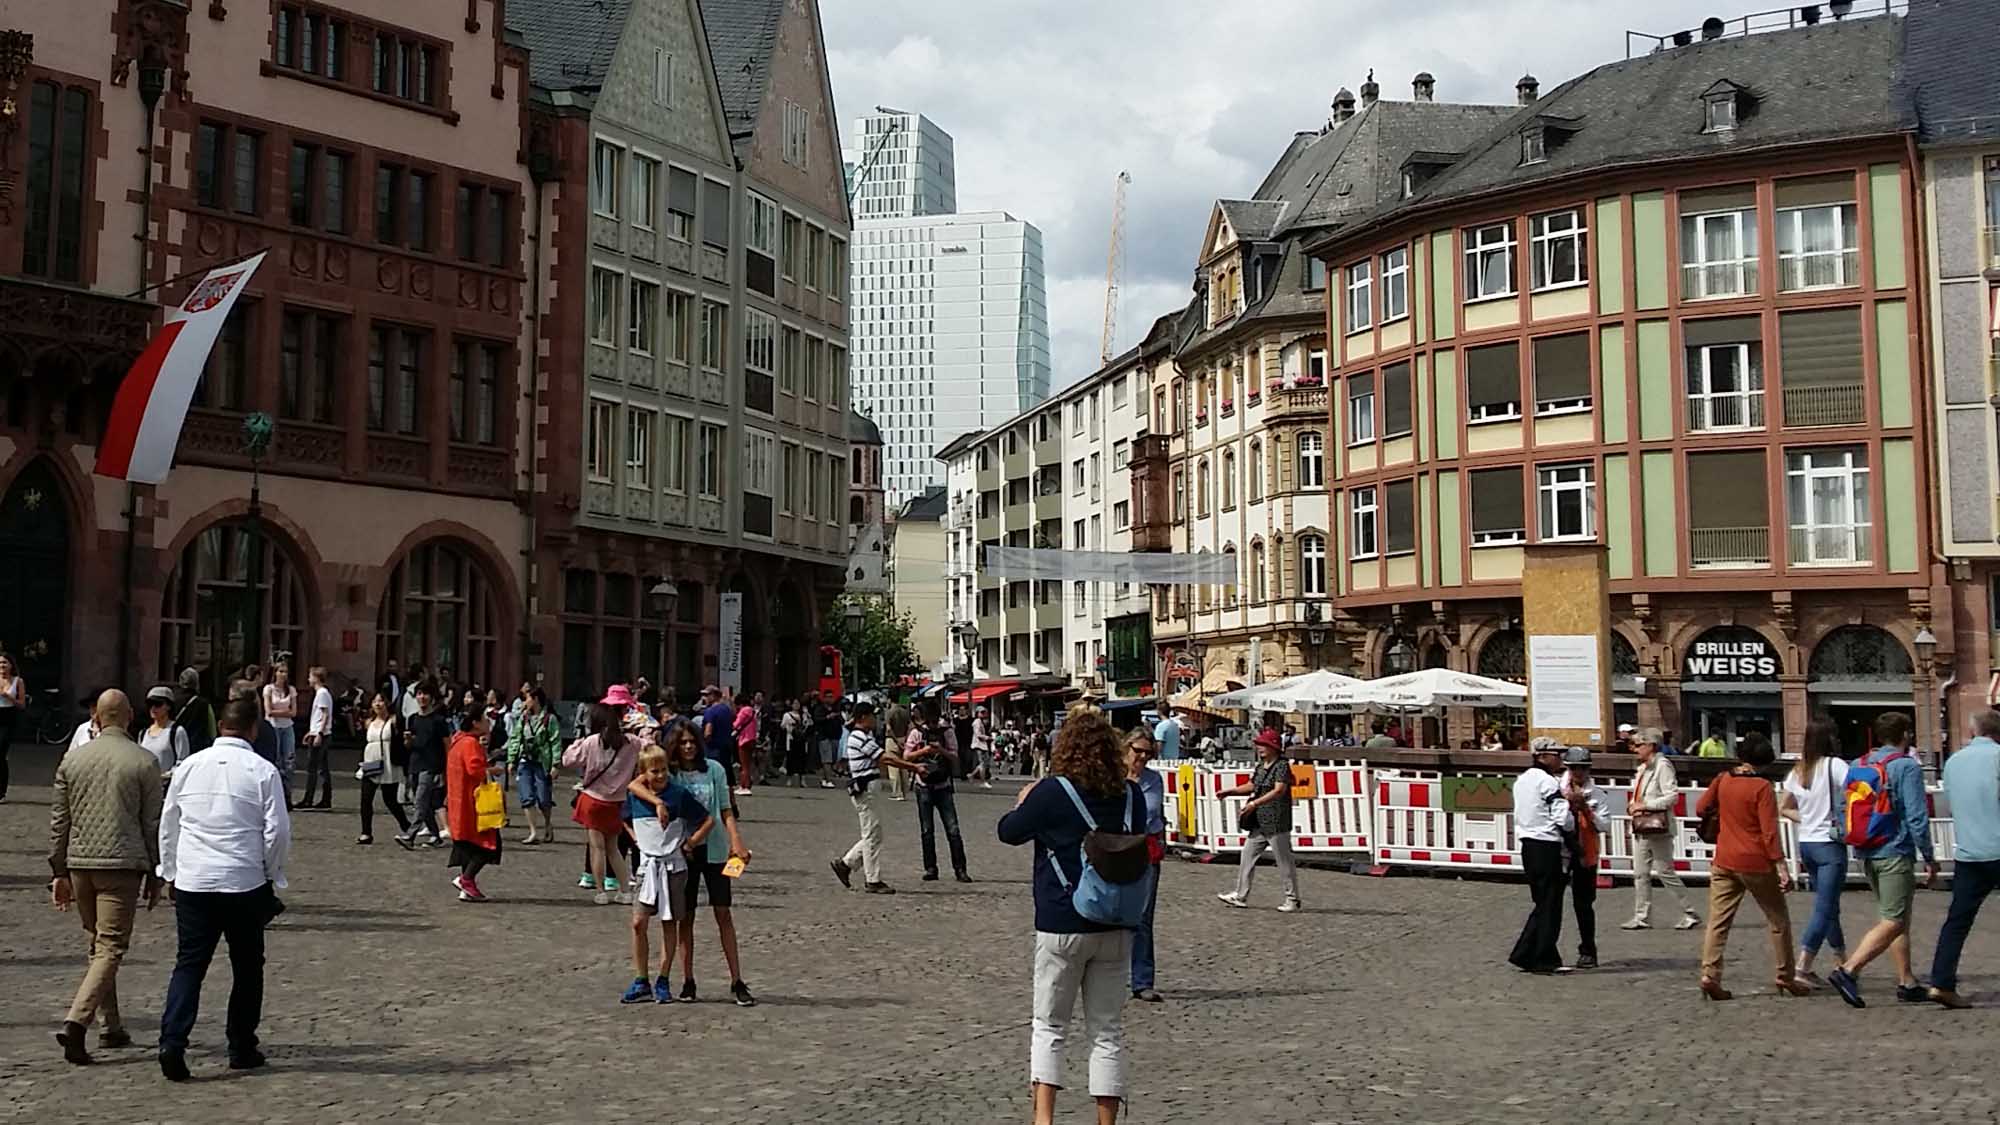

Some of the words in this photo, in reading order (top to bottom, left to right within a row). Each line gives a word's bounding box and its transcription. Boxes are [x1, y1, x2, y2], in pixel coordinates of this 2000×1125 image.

[728, 638, 741, 672] Tourist
[1696, 642, 1764, 655] BRILLEN
[1688, 657, 1775, 675] WEISS
